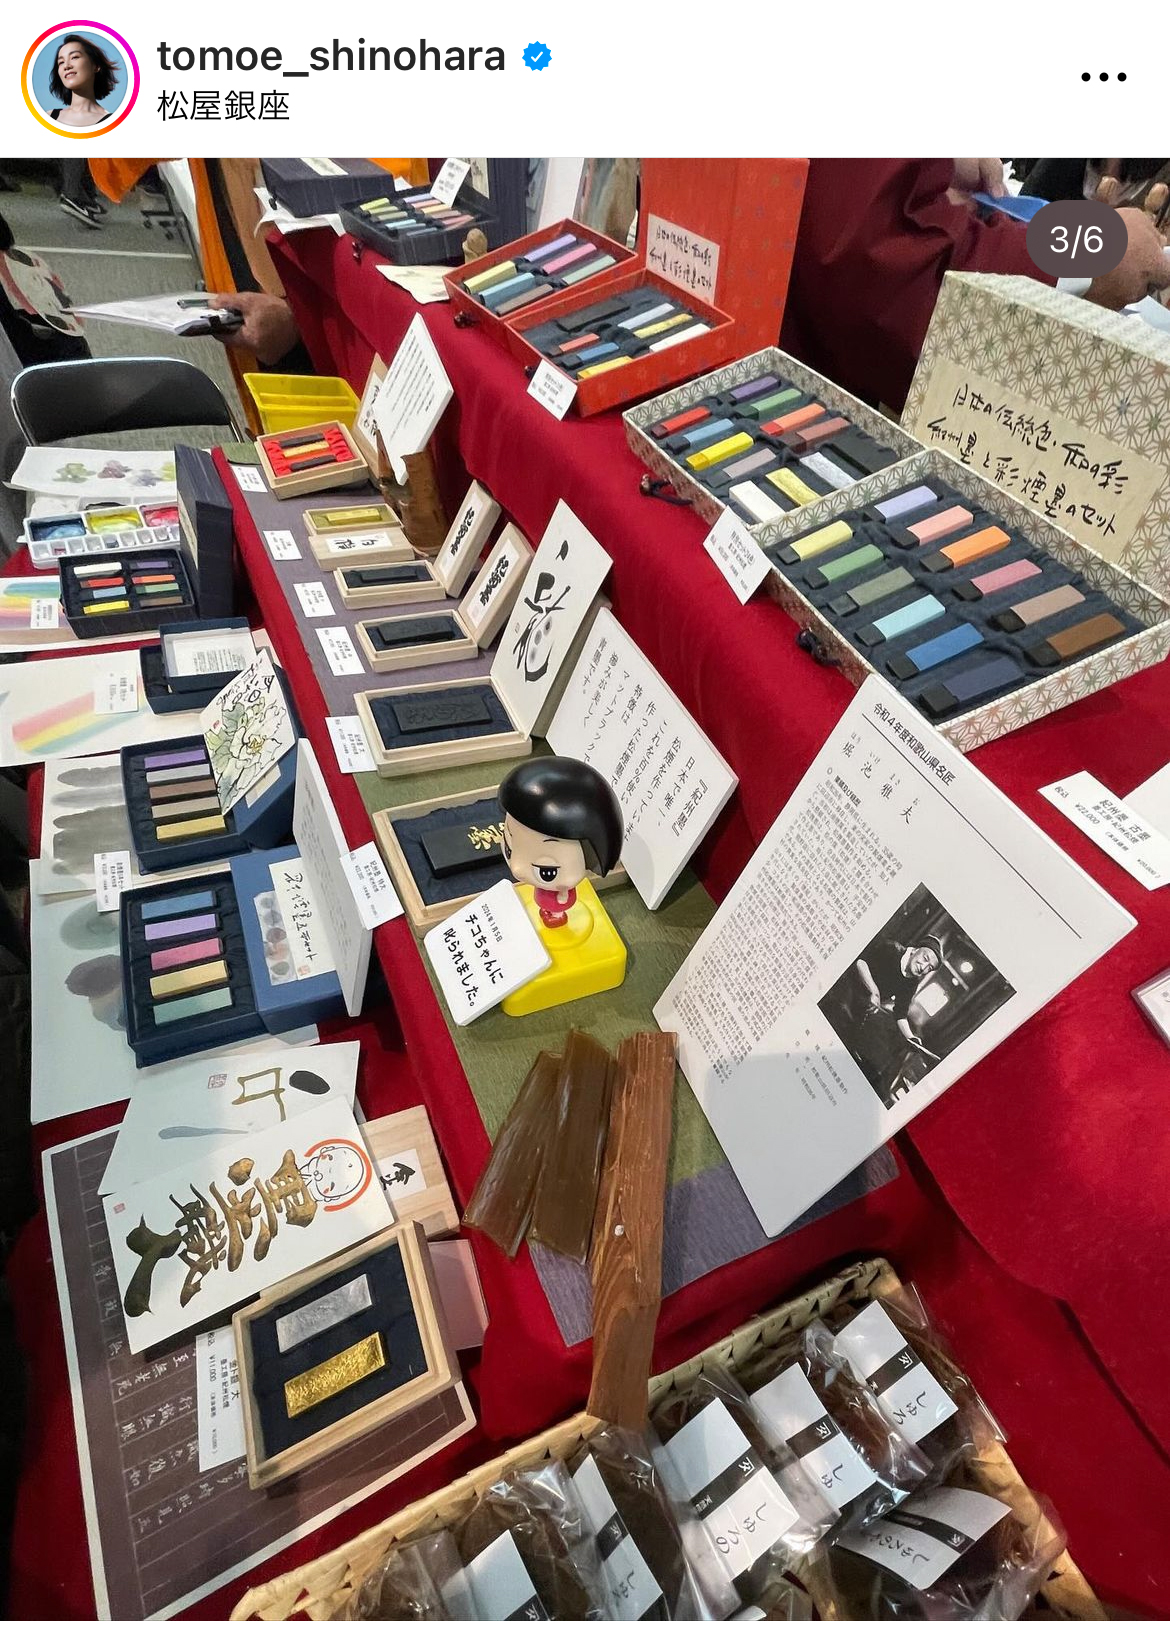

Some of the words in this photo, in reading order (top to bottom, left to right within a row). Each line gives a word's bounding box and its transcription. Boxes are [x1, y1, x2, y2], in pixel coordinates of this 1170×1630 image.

[582, 637, 607, 694] 青墨です。
[583, 652, 619, 727] 滲みが美しく
[584, 670, 630, 765] マットブラックで
[621, 684, 644, 724] 特徴は
[874, 703, 957, 786] 令和4年度和歌山県名匠
[658, 756, 696, 827] 日本で唯一、
[671, 779, 709, 837] 『紀州墨』
[1054, 786, 1069, 799] 税込
[1074, 803, 1100, 825] ¥22,000
[443, 928, 479, 1007] 叱られました。
[465, 914, 504, 984] チコちゃんに
[116, 1348, 198, 1396] 至無老死
[231, 1390, 240, 1400] 大
[893, 1391, 927, 1425] しゅろ
[821, 1463, 844, 1489] しゅ
[716, 1502, 767, 1554] しゅろの
